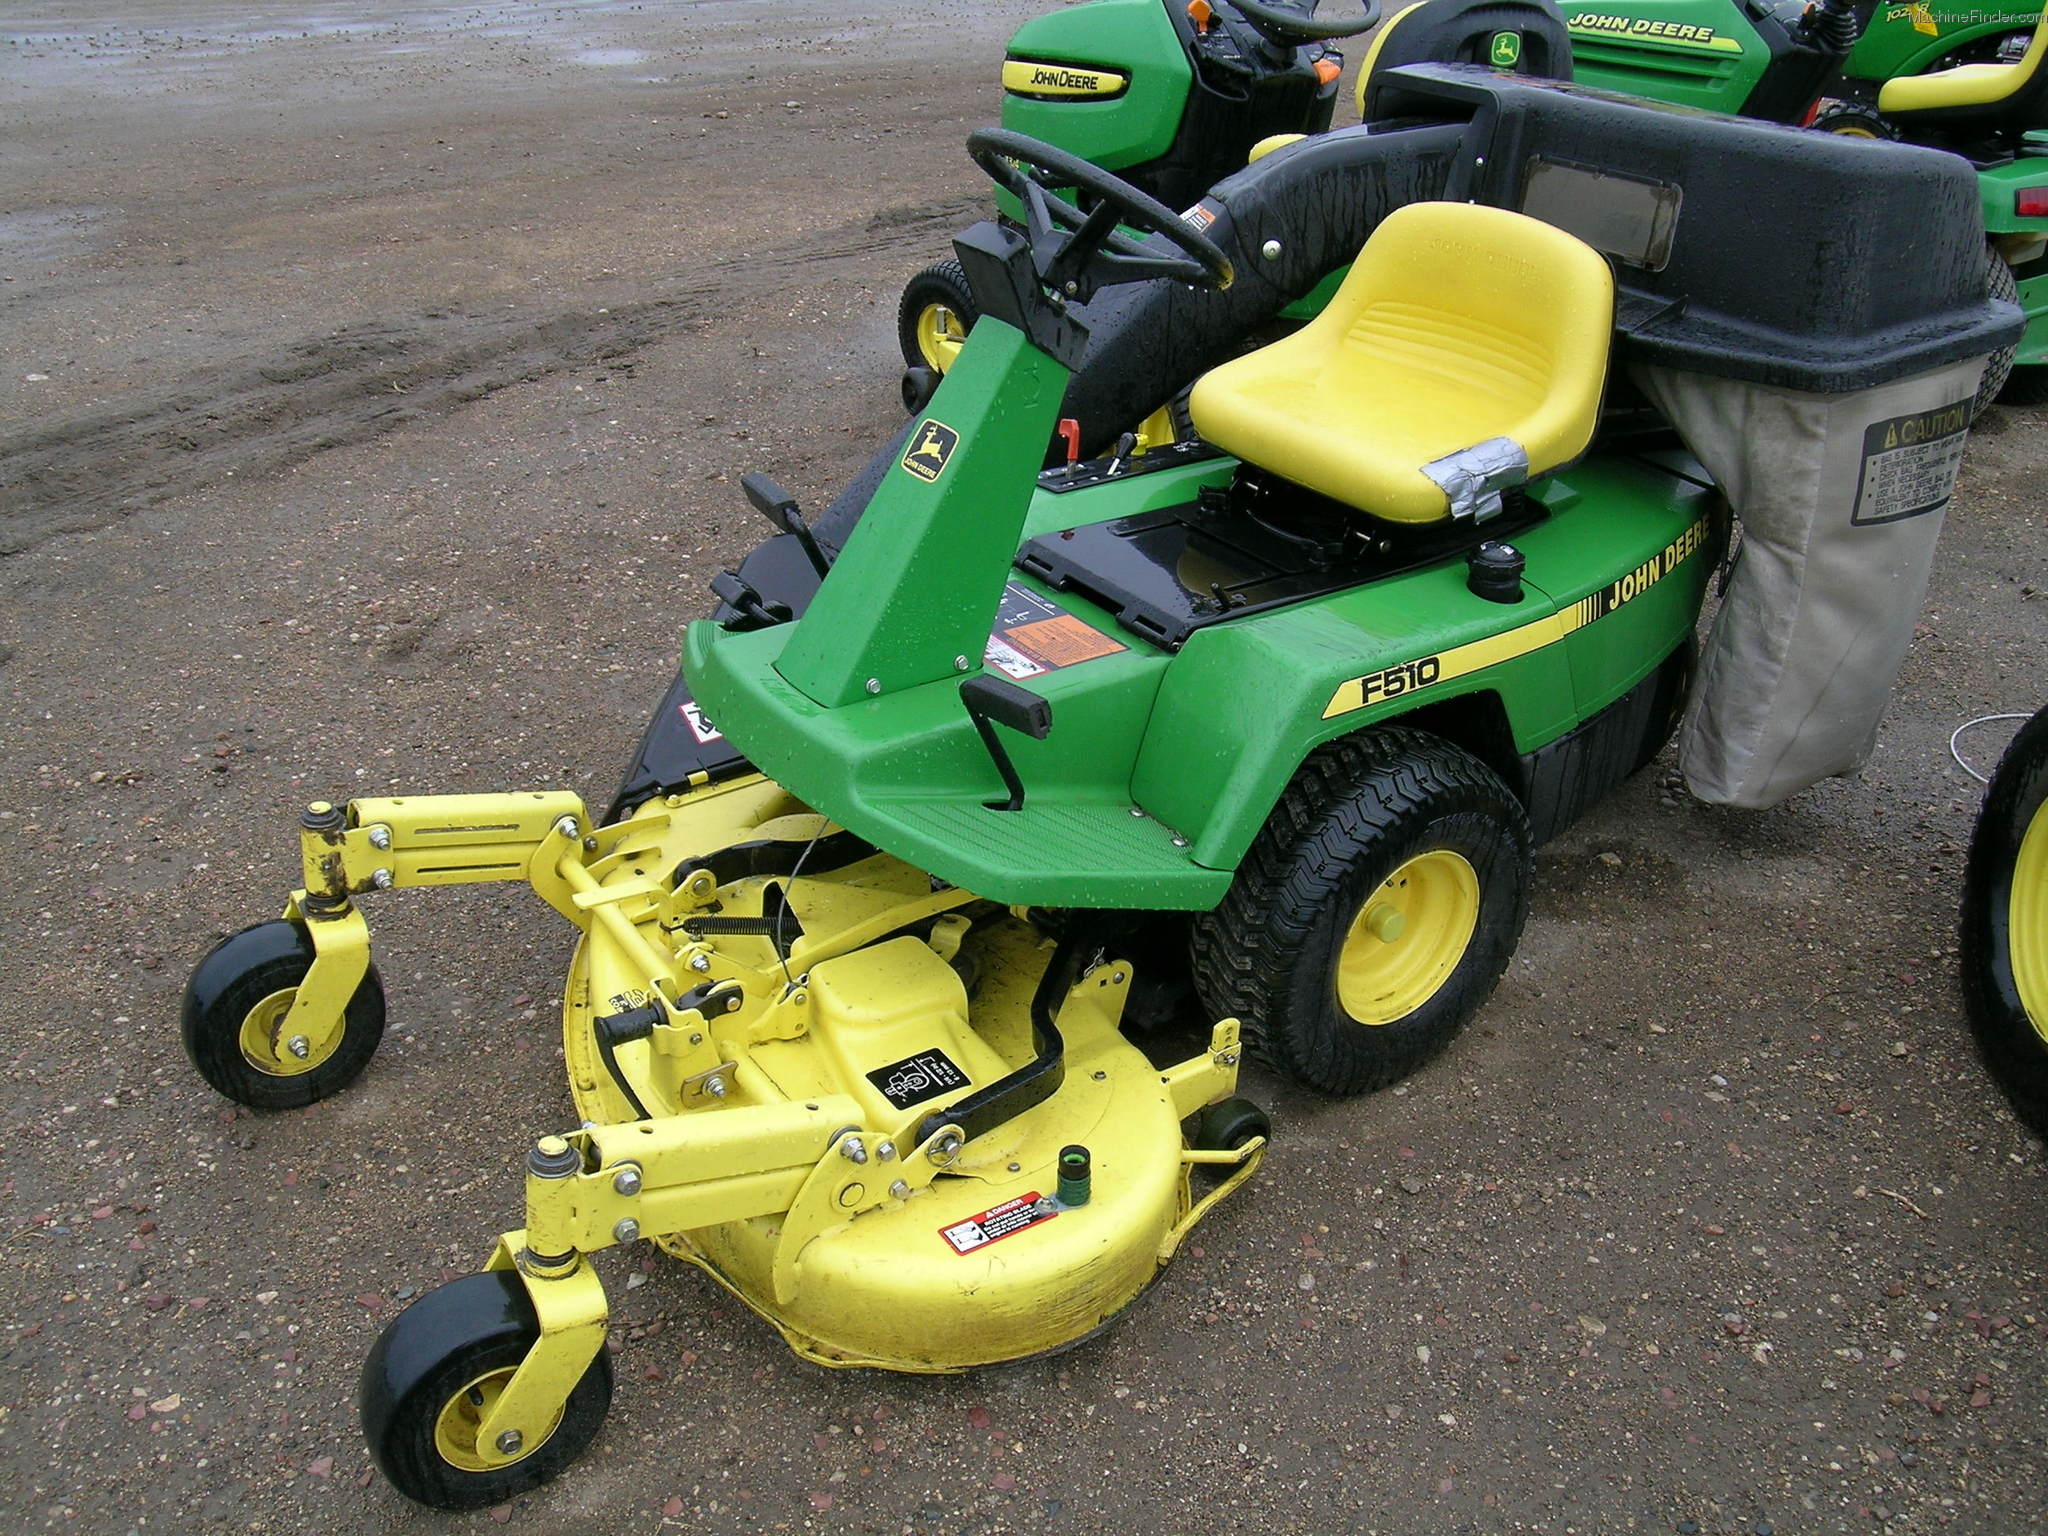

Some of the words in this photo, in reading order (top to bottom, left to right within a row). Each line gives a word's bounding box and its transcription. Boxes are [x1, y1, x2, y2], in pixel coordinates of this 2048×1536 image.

[1568, 12, 1631, 32] JOHN
[1632, 19, 1714, 43] DEERE
[1030, 68, 1059, 85] JOHN
[1058, 70, 1098, 90] DEERE
[1901, 405, 1964, 443] CAUTION
[903, 457, 919, 470] JOHN
[917, 463, 938, 479] DEERE
[1609, 555, 1660, 610] JOHN
[1665, 513, 1710, 574] DEERE
[1361, 656, 1440, 704] F510
[991, 1198, 1023, 1214] DANGER
